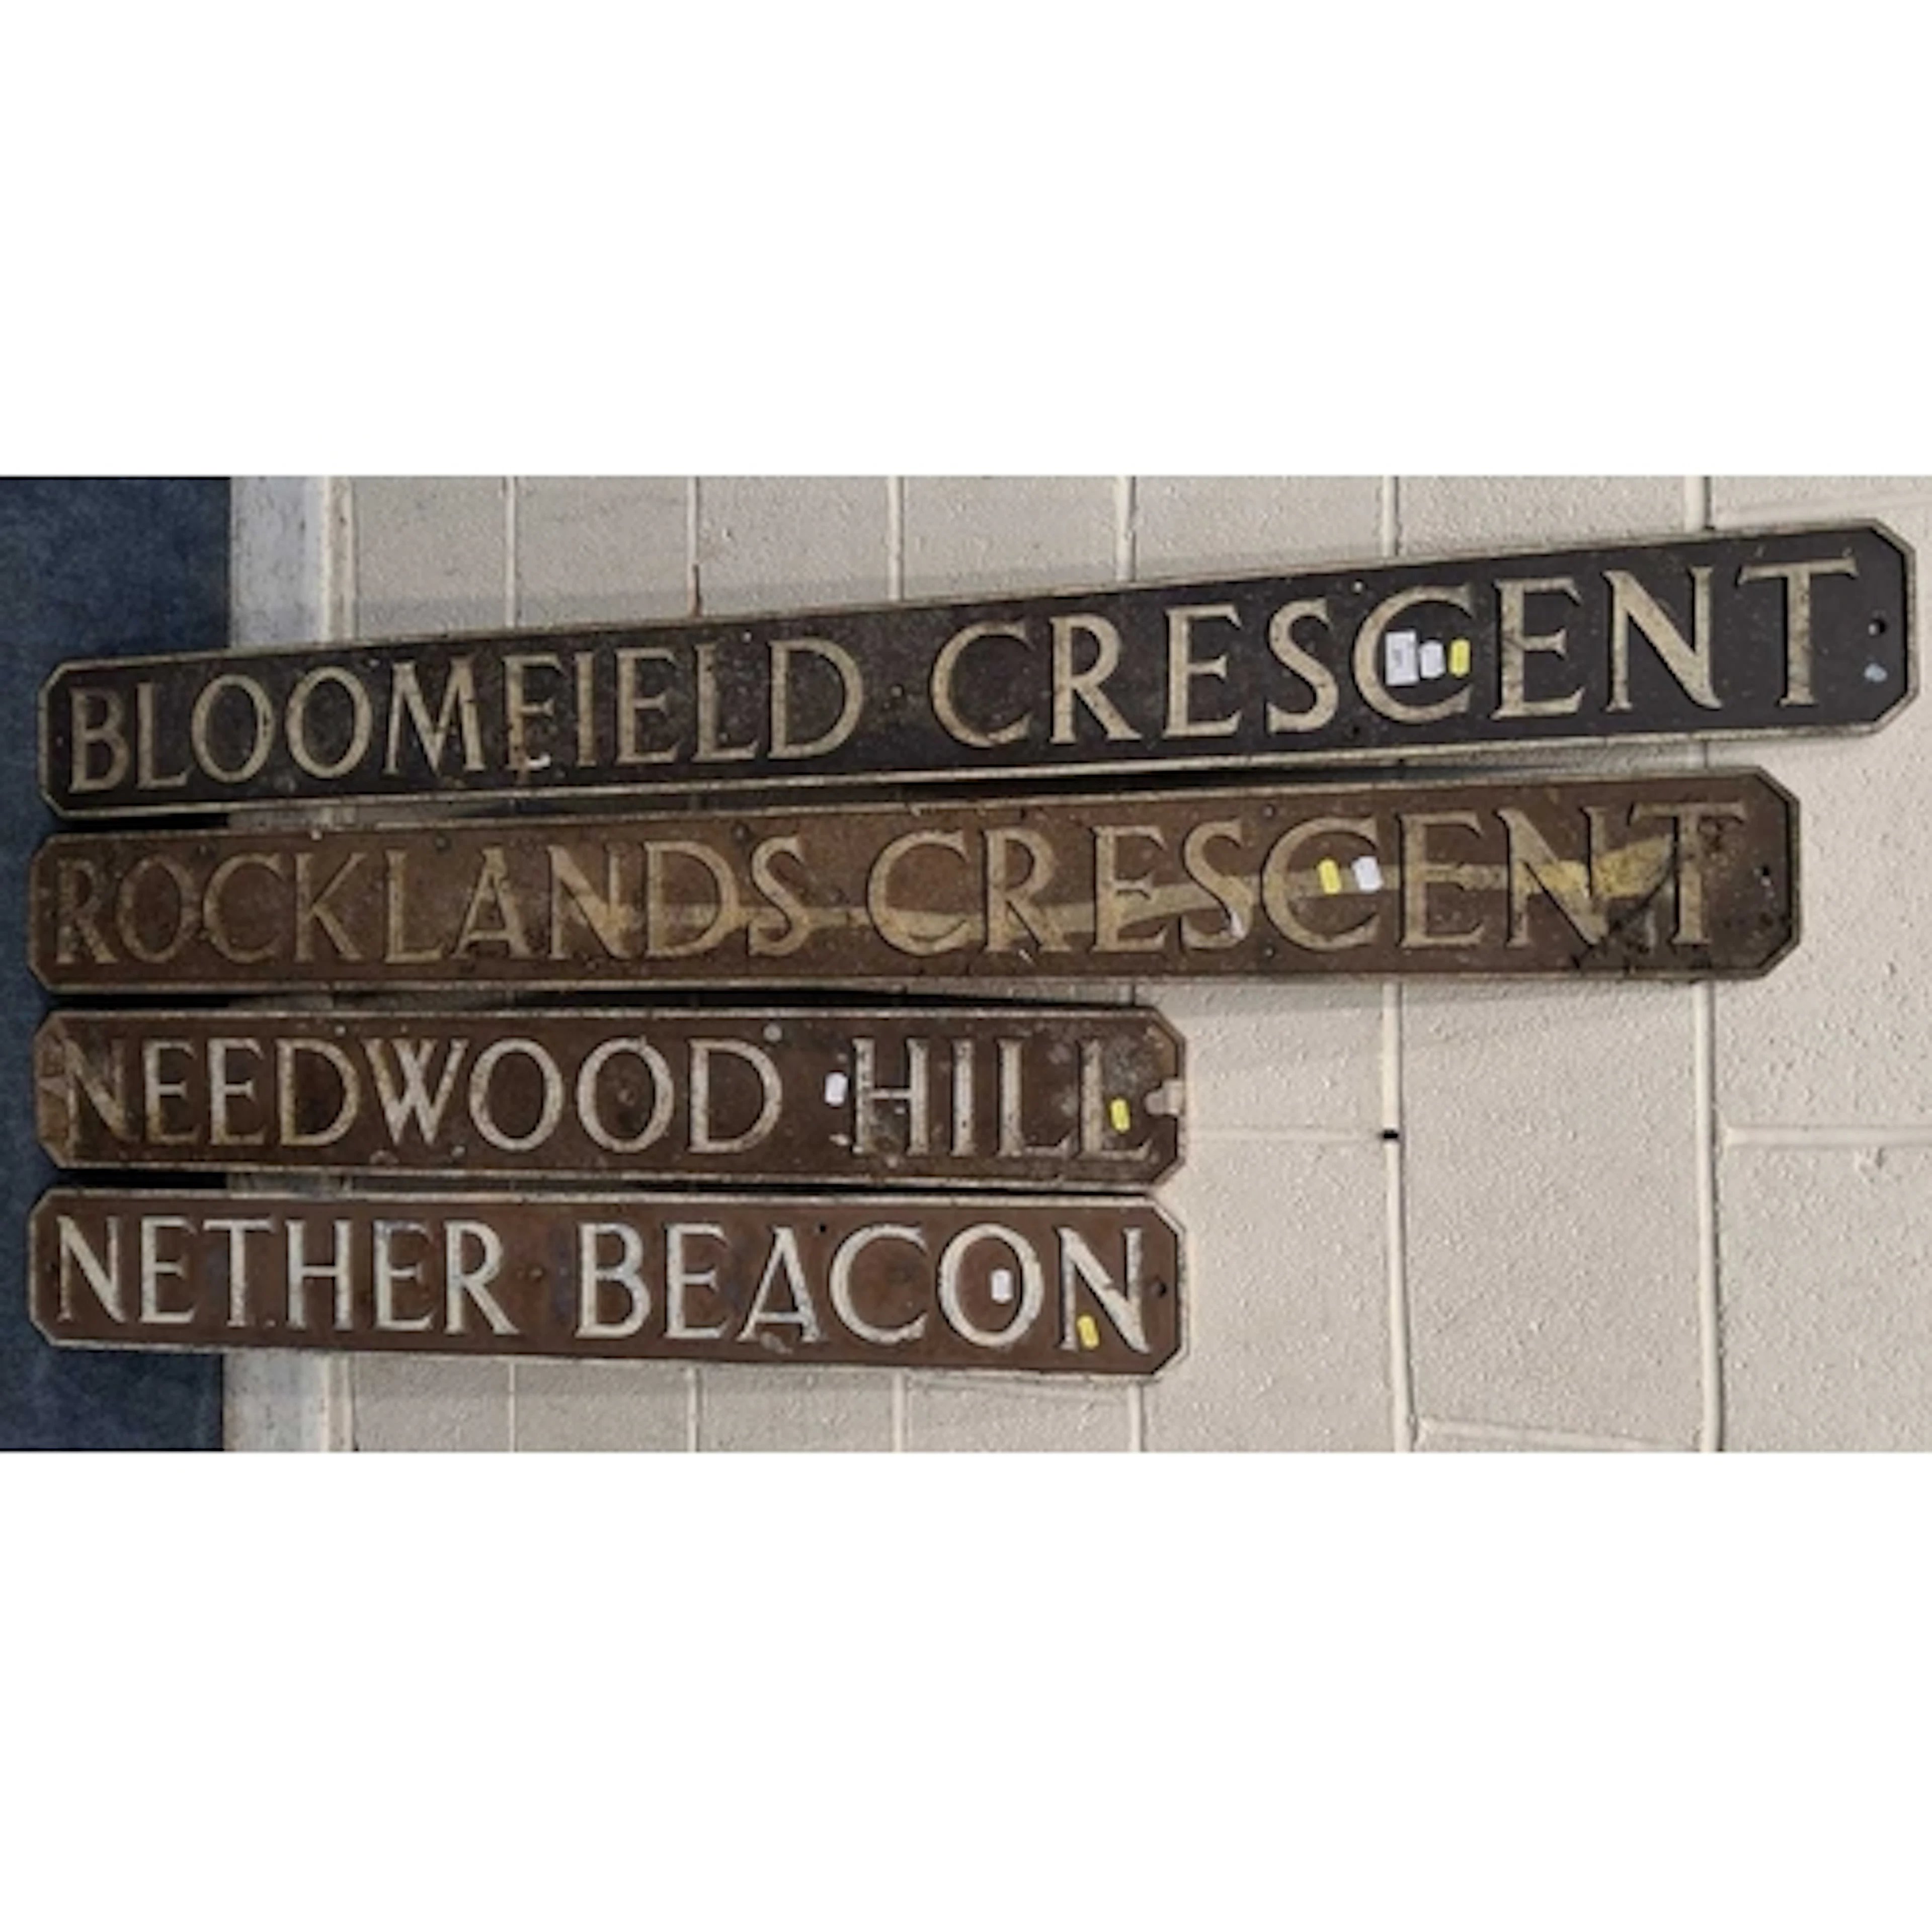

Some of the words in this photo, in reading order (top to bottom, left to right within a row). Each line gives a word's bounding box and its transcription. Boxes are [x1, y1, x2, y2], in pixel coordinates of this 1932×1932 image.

[69, 637, 864, 794] BLOOMFIELD
[931, 557, 1859, 749] CRESCENT
[55, 834, 810, 966] ROCKLANDS
[867, 801, 1748, 957] CRESCENT
[61, 1036, 784, 1155] NEEDWOOD
[852, 1036, 1153, 1161] HILL
[56, 1217, 520, 1336] NETHER
[577, 1222, 1151, 1354] BEACON
